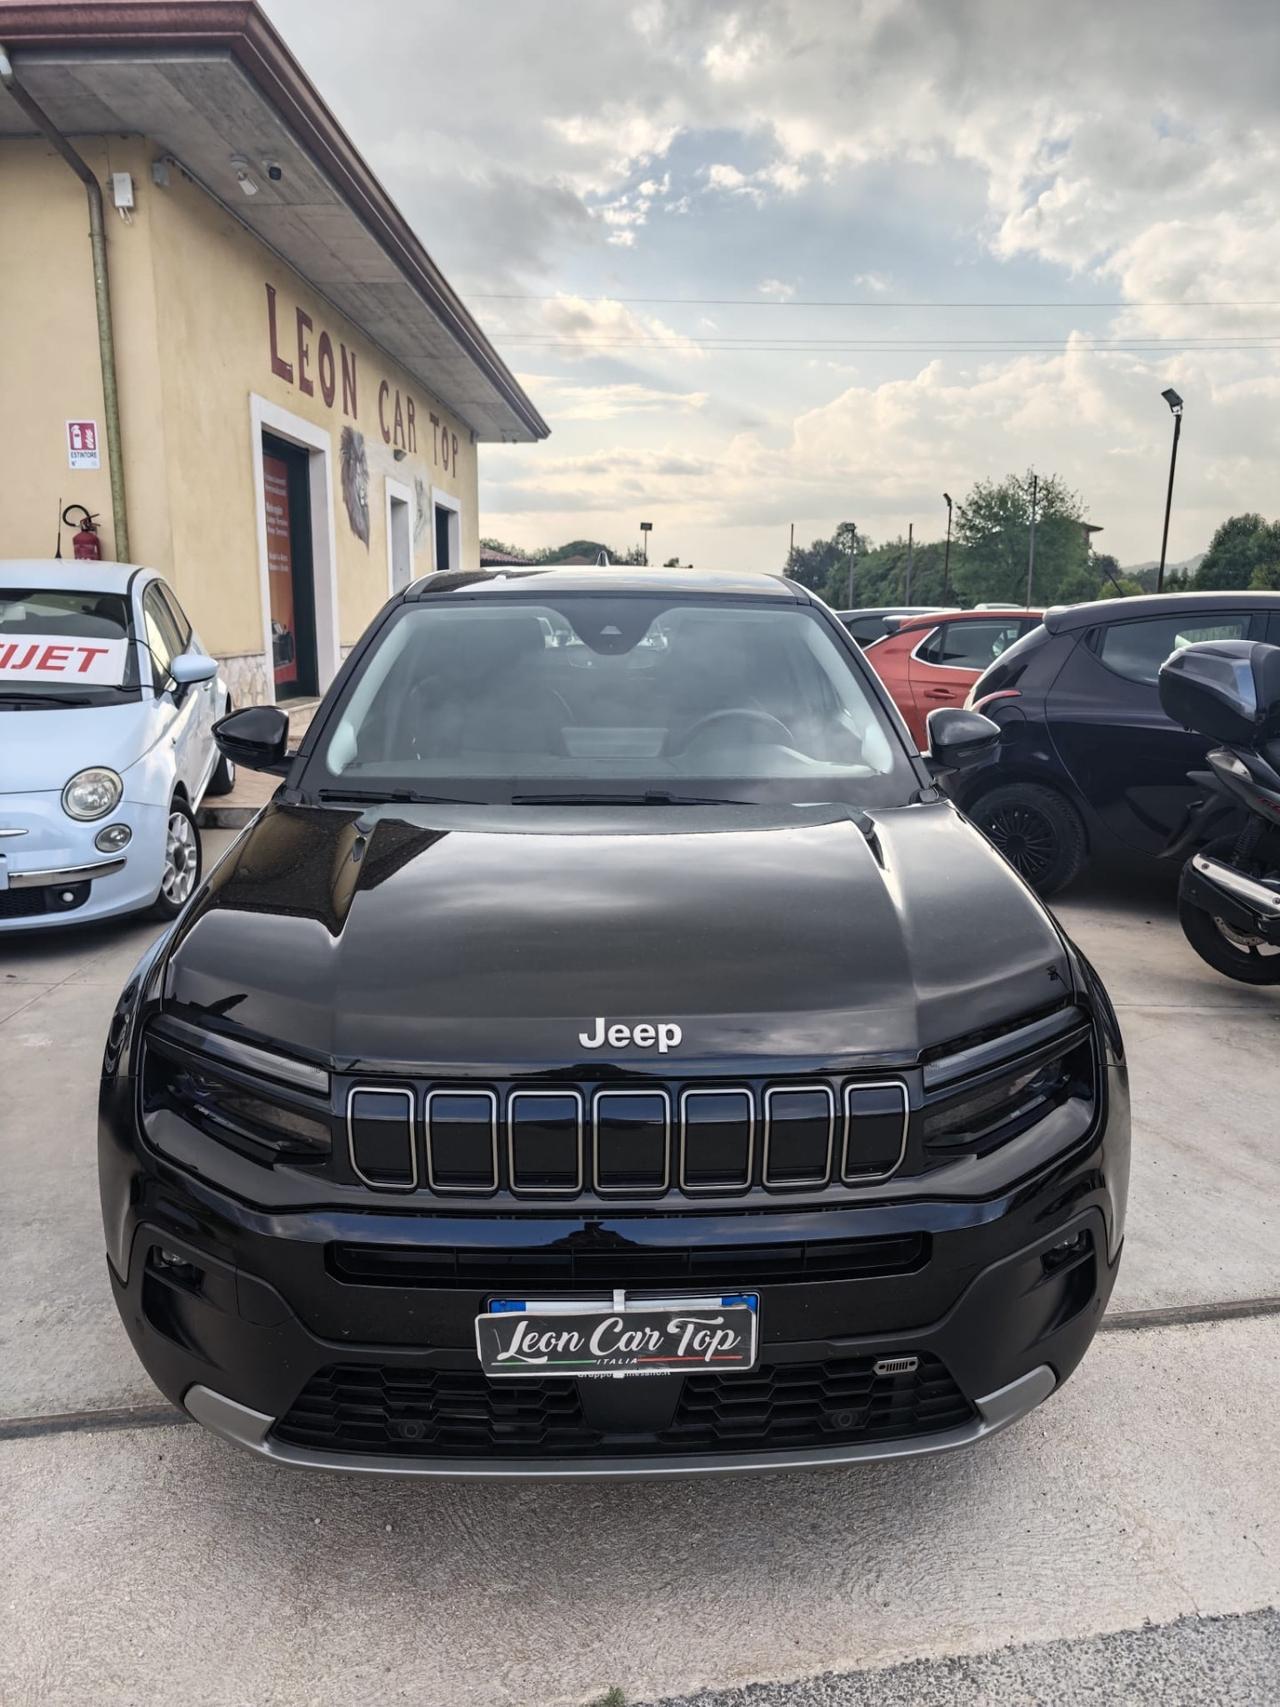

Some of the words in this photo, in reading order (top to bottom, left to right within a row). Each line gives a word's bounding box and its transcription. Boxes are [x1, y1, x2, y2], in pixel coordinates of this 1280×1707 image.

[265, 283, 358, 420] LEON
[378, 379, 417, 454] CAR
[430, 412, 459, 478] TOP
[0, 643, 109, 673] IJET
[579, 1017, 683, 1054] Jeep
[497, 1320, 584, 1364] Leon
[590, 1317, 664, 1356] Car
[667, 1316, 742, 1362] Top
[596, 1358, 638, 1366] ITALIA
